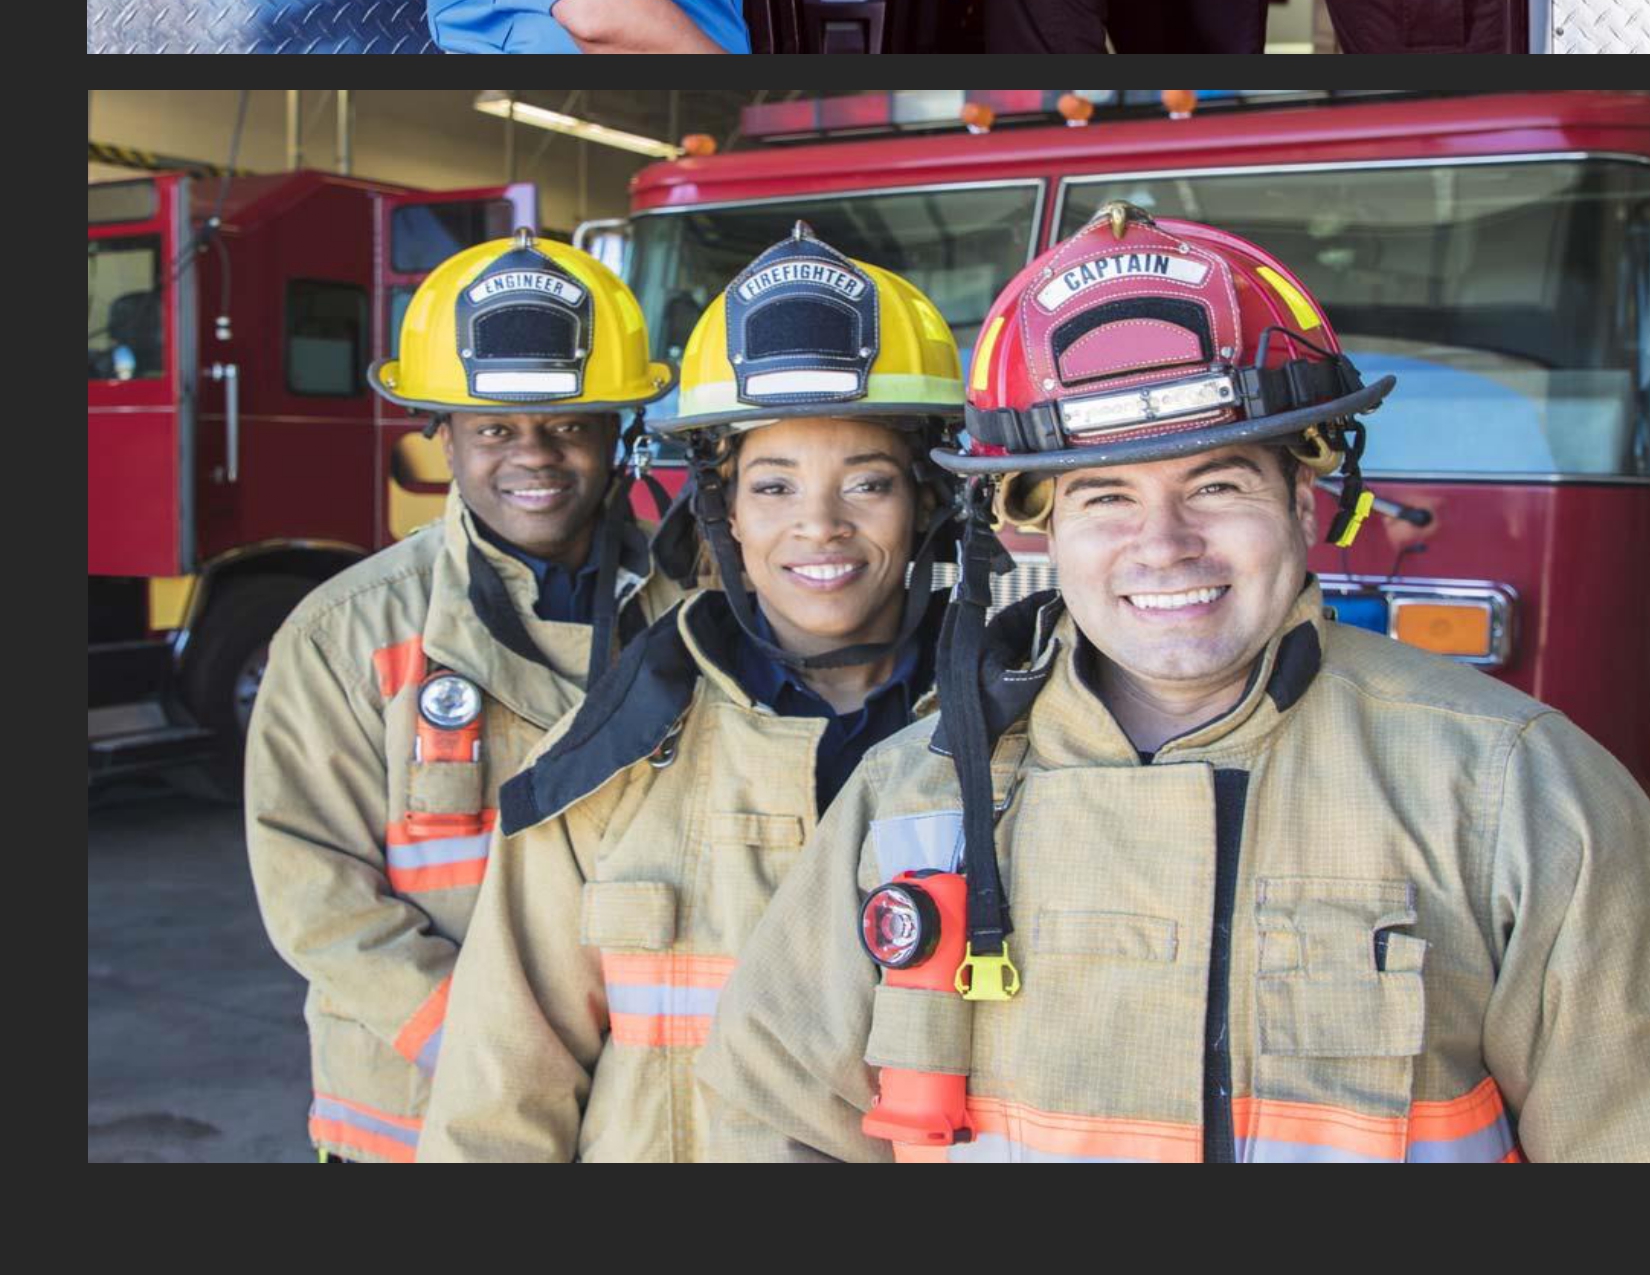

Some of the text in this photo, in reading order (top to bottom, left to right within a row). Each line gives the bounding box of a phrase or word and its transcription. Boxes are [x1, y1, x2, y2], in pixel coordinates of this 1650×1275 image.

[485, 273, 564, 294] ENGINEER
[746, 264, 857, 295] FIREFIGHTER
[1064, 254, 1169, 291] CAPTAIN
